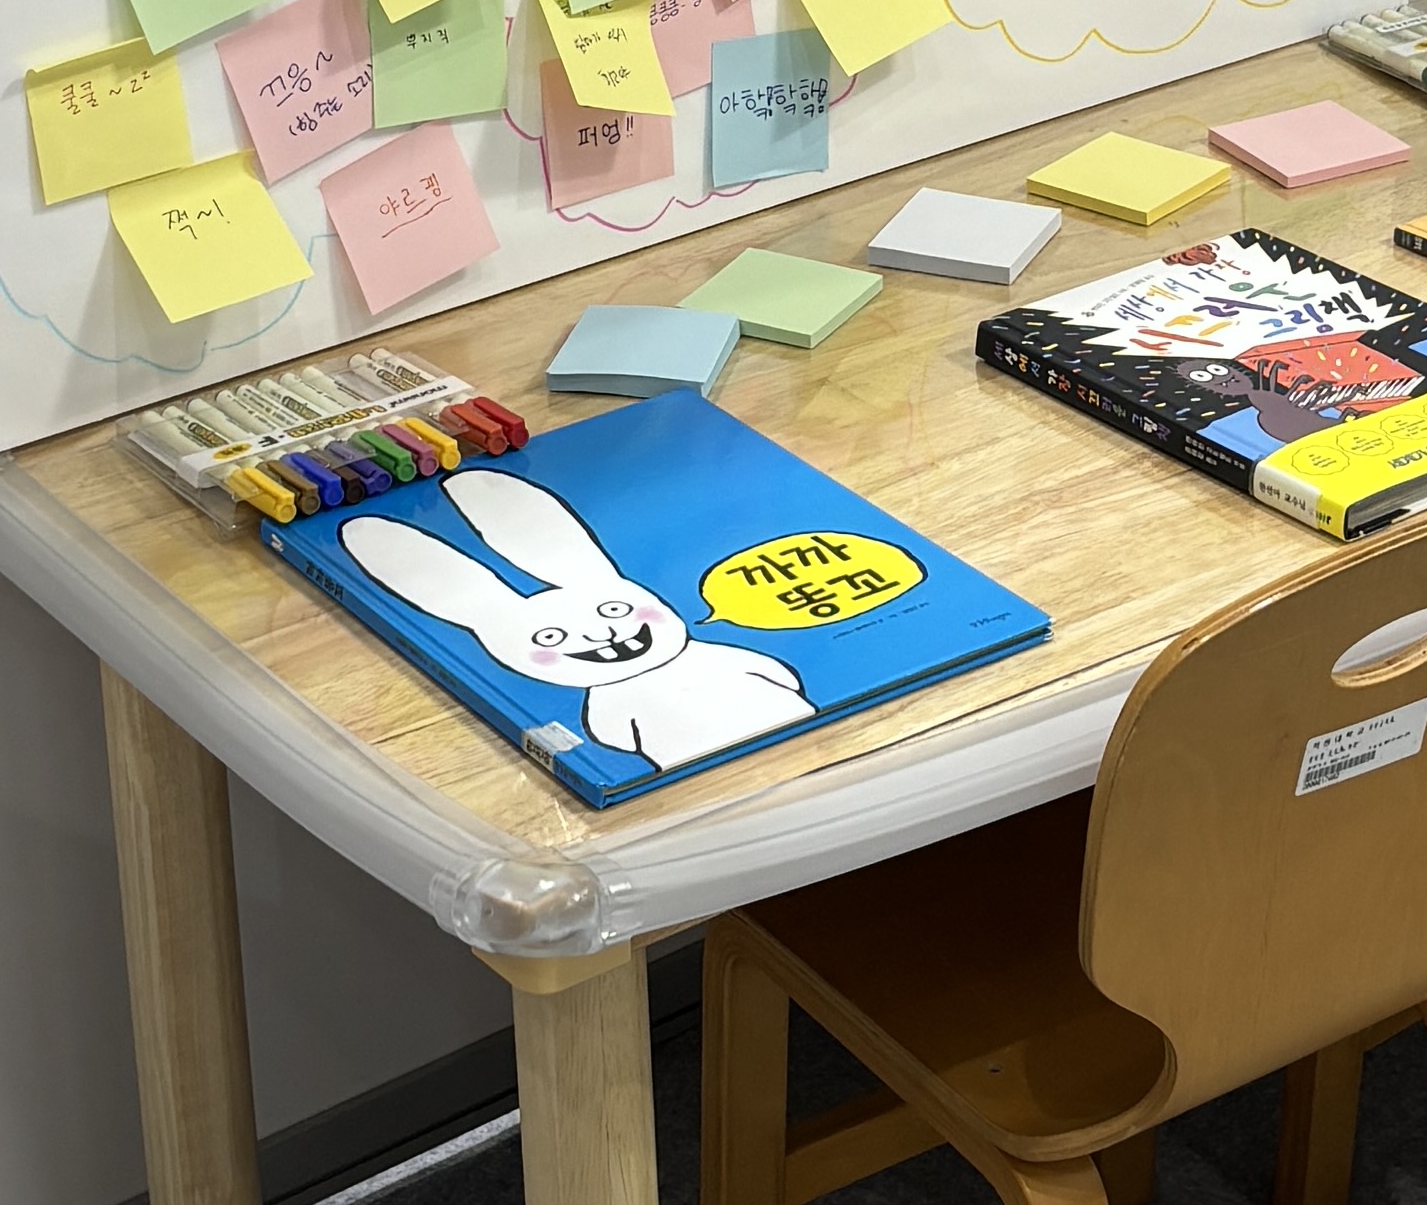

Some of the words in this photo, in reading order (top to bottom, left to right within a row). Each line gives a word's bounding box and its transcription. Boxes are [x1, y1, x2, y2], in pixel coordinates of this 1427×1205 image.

[1114, 277, 1201, 322] 세상에서
[1188, 258, 1251, 282] 가장
[1128, 281, 1318, 355] 시끄러운
[1258, 290, 1376, 339] 그림책
[724, 534, 853, 588] 까까
[777, 565, 902, 621] 똥꼬
